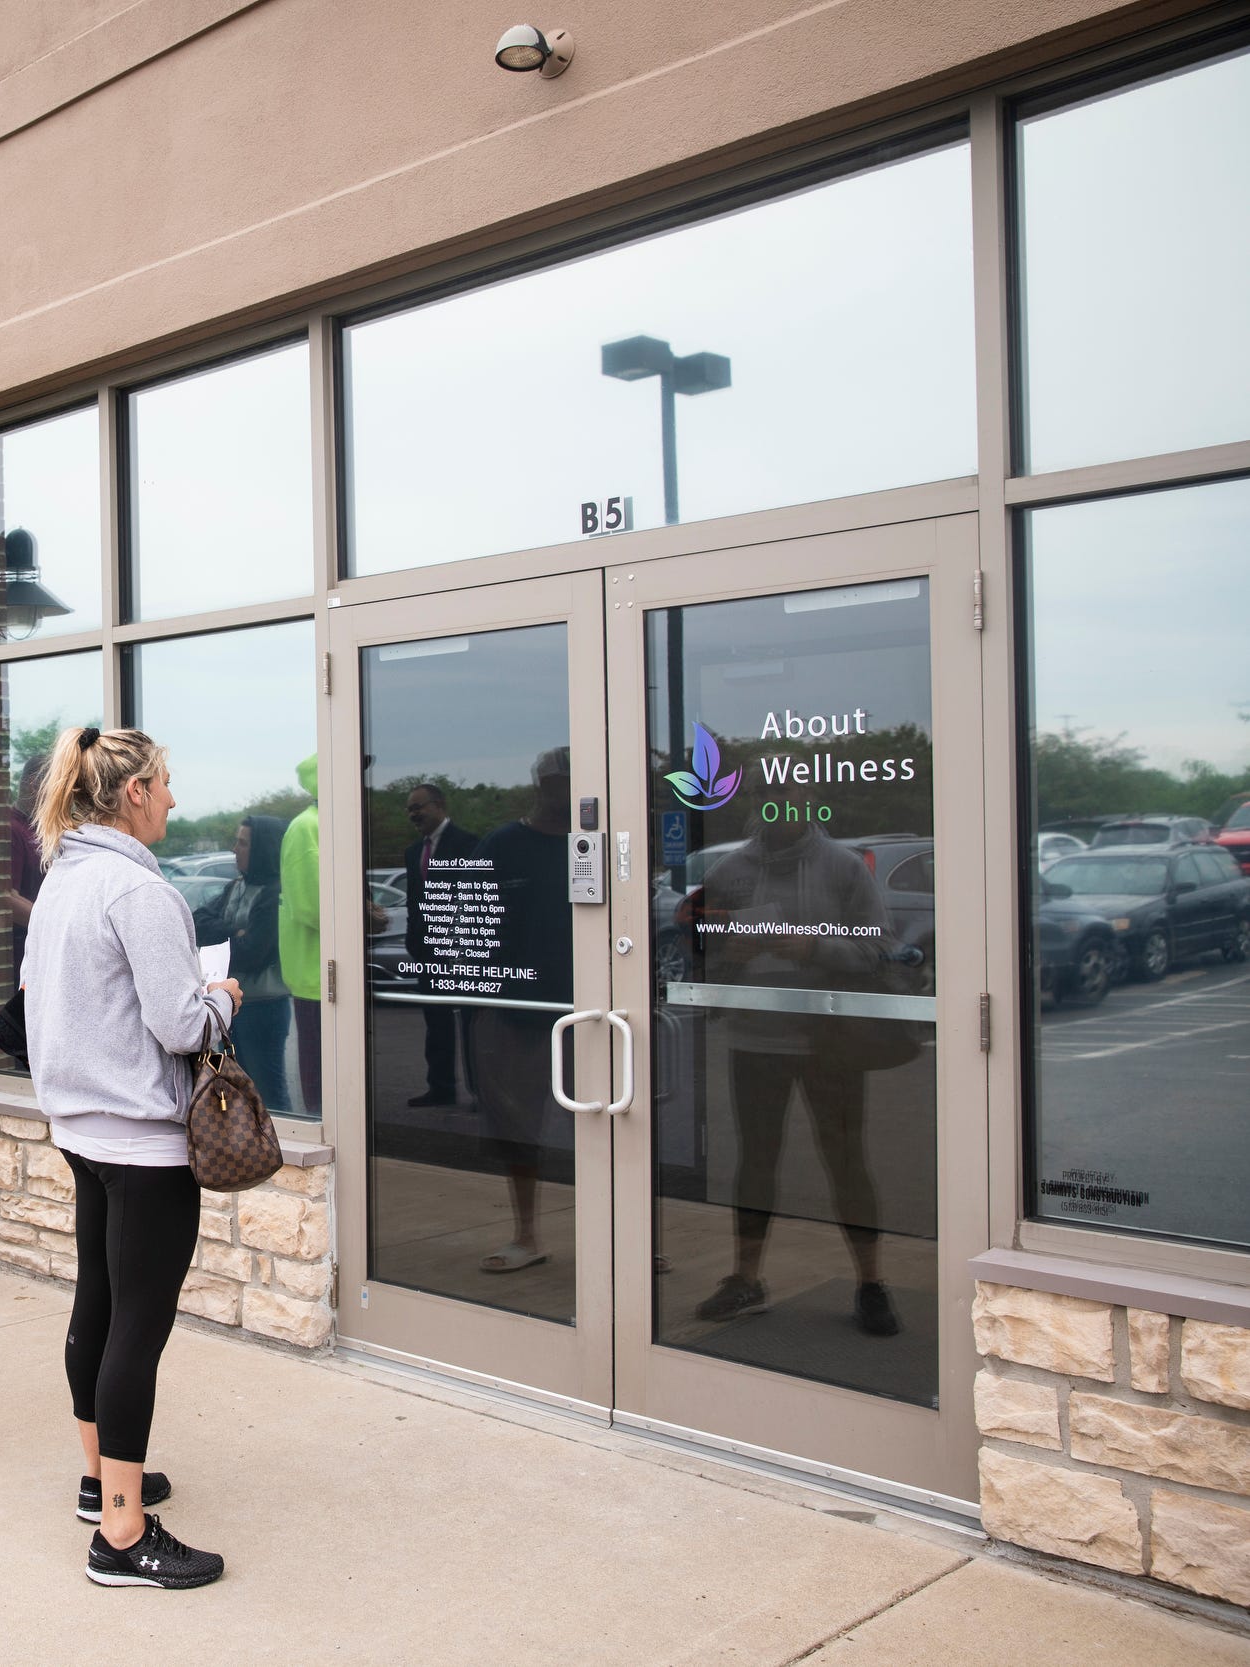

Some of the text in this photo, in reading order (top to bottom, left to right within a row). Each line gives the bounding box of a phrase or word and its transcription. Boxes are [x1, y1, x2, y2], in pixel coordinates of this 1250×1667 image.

[581, 496, 622, 534] B5
[761, 708, 865, 739] About
[761, 754, 915, 784] Wellness
[761, 801, 832, 823] Ohio
[618, 833, 629, 877] PULL
[429, 858, 493, 868] Hours of Operation
[424, 881, 451, 890] Monday
[457, 881, 472, 890] 9am
[474, 881, 481, 890] to
[482, 882, 498, 891] 6pm
[424, 892, 452, 901] Tuesday
[458, 892, 473, 901] 9am
[475, 893, 482, 901] to
[483, 893, 499, 902] 6pm
[419, 903, 458, 913] Wednesday
[463, 904, 479, 912] 9am
[480, 904, 488, 912] to
[489, 904, 505, 914] 6pm
[423, 914, 454, 924] Thursday
[459, 915, 475, 923] 9am
[476, 916, 484, 924] to
[485, 916, 501, 926] 6pm
[428, 925, 449, 935] Friday
[455, 926, 470, 934] 9am
[471, 927, 479, 935] to
[479, 927, 495, 937] 6pm
[696, 921, 881, 937] www.AboutWellnessOhio.com
[424, 936, 454, 946] Saturday
[459, 937, 475, 946] 9am
[476, 938, 483, 946] to
[484, 939, 500, 948] 3pm
[434, 948, 459, 959] Sunday
[465, 949, 490, 959] Closed
[398, 962, 537, 980] OHIO TOLL-FREE HELPLINE:
[430, 979, 502, 993] 1-833-464-6627
